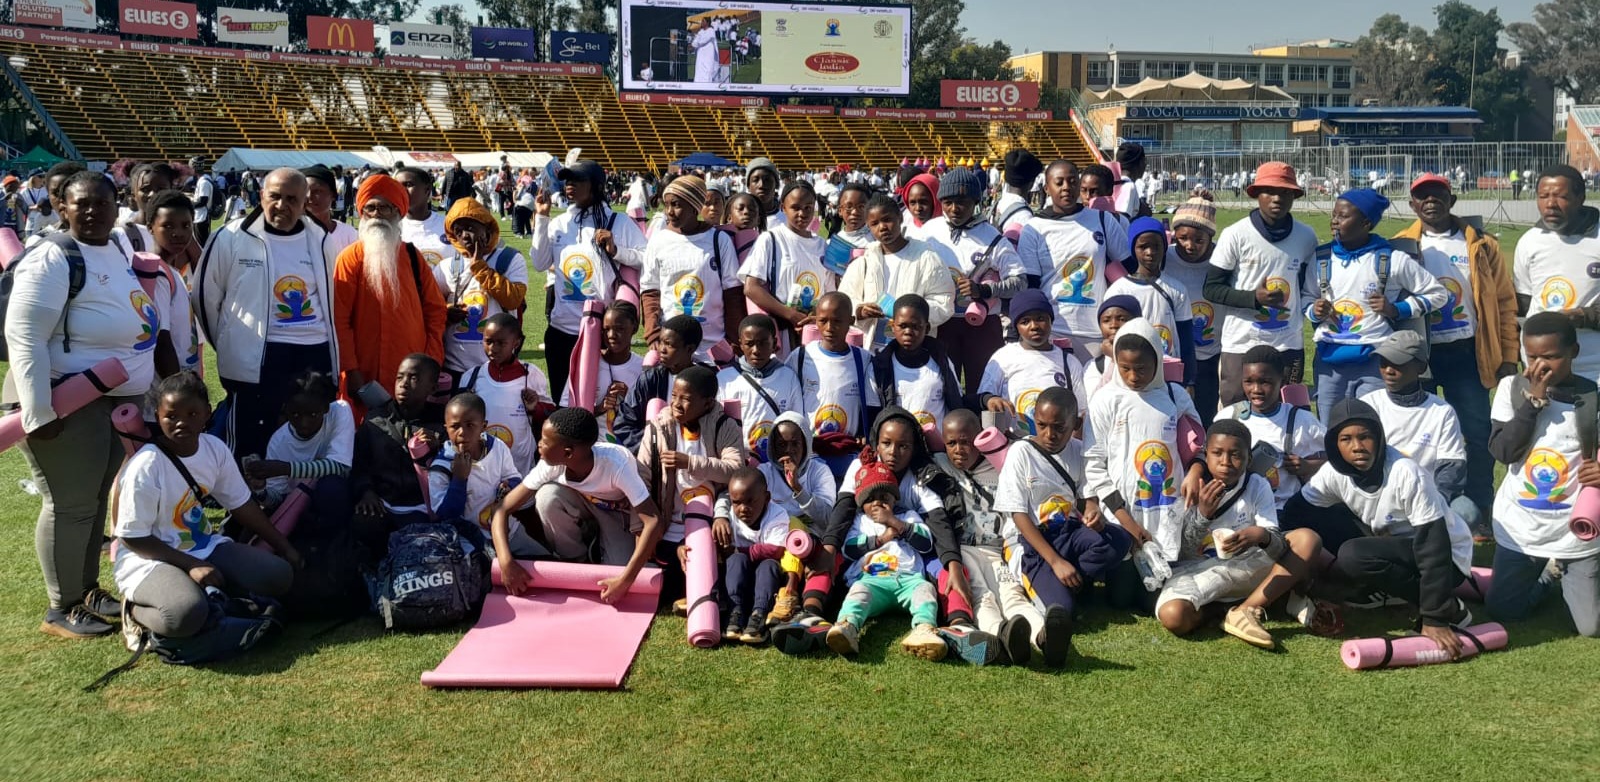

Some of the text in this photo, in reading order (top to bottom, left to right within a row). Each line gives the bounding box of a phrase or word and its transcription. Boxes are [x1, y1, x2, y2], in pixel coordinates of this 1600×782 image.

[17, 4, 61, 13] SOLUTIONS
[16, 11, 53, 20] PARTNER
[124, 8, 169, 26] ELLIES
[0, 28, 13, 37] IES
[40, 33, 77, 43] Powering
[131, 43, 150, 51] ELLIES
[170, 46, 203, 55] Powering
[559, 37, 600, 57] Sun Bet
[390, 59, 423, 68] Powering
[500, 64, 532, 72] Powering
[956, 86, 998, 103] ELLIES
[667, 96, 697, 104] Powering
[1145, 106, 1180, 117] YOGA
[1245, 106, 1282, 117] YOGA
[393, 571, 454, 598] KINGS
